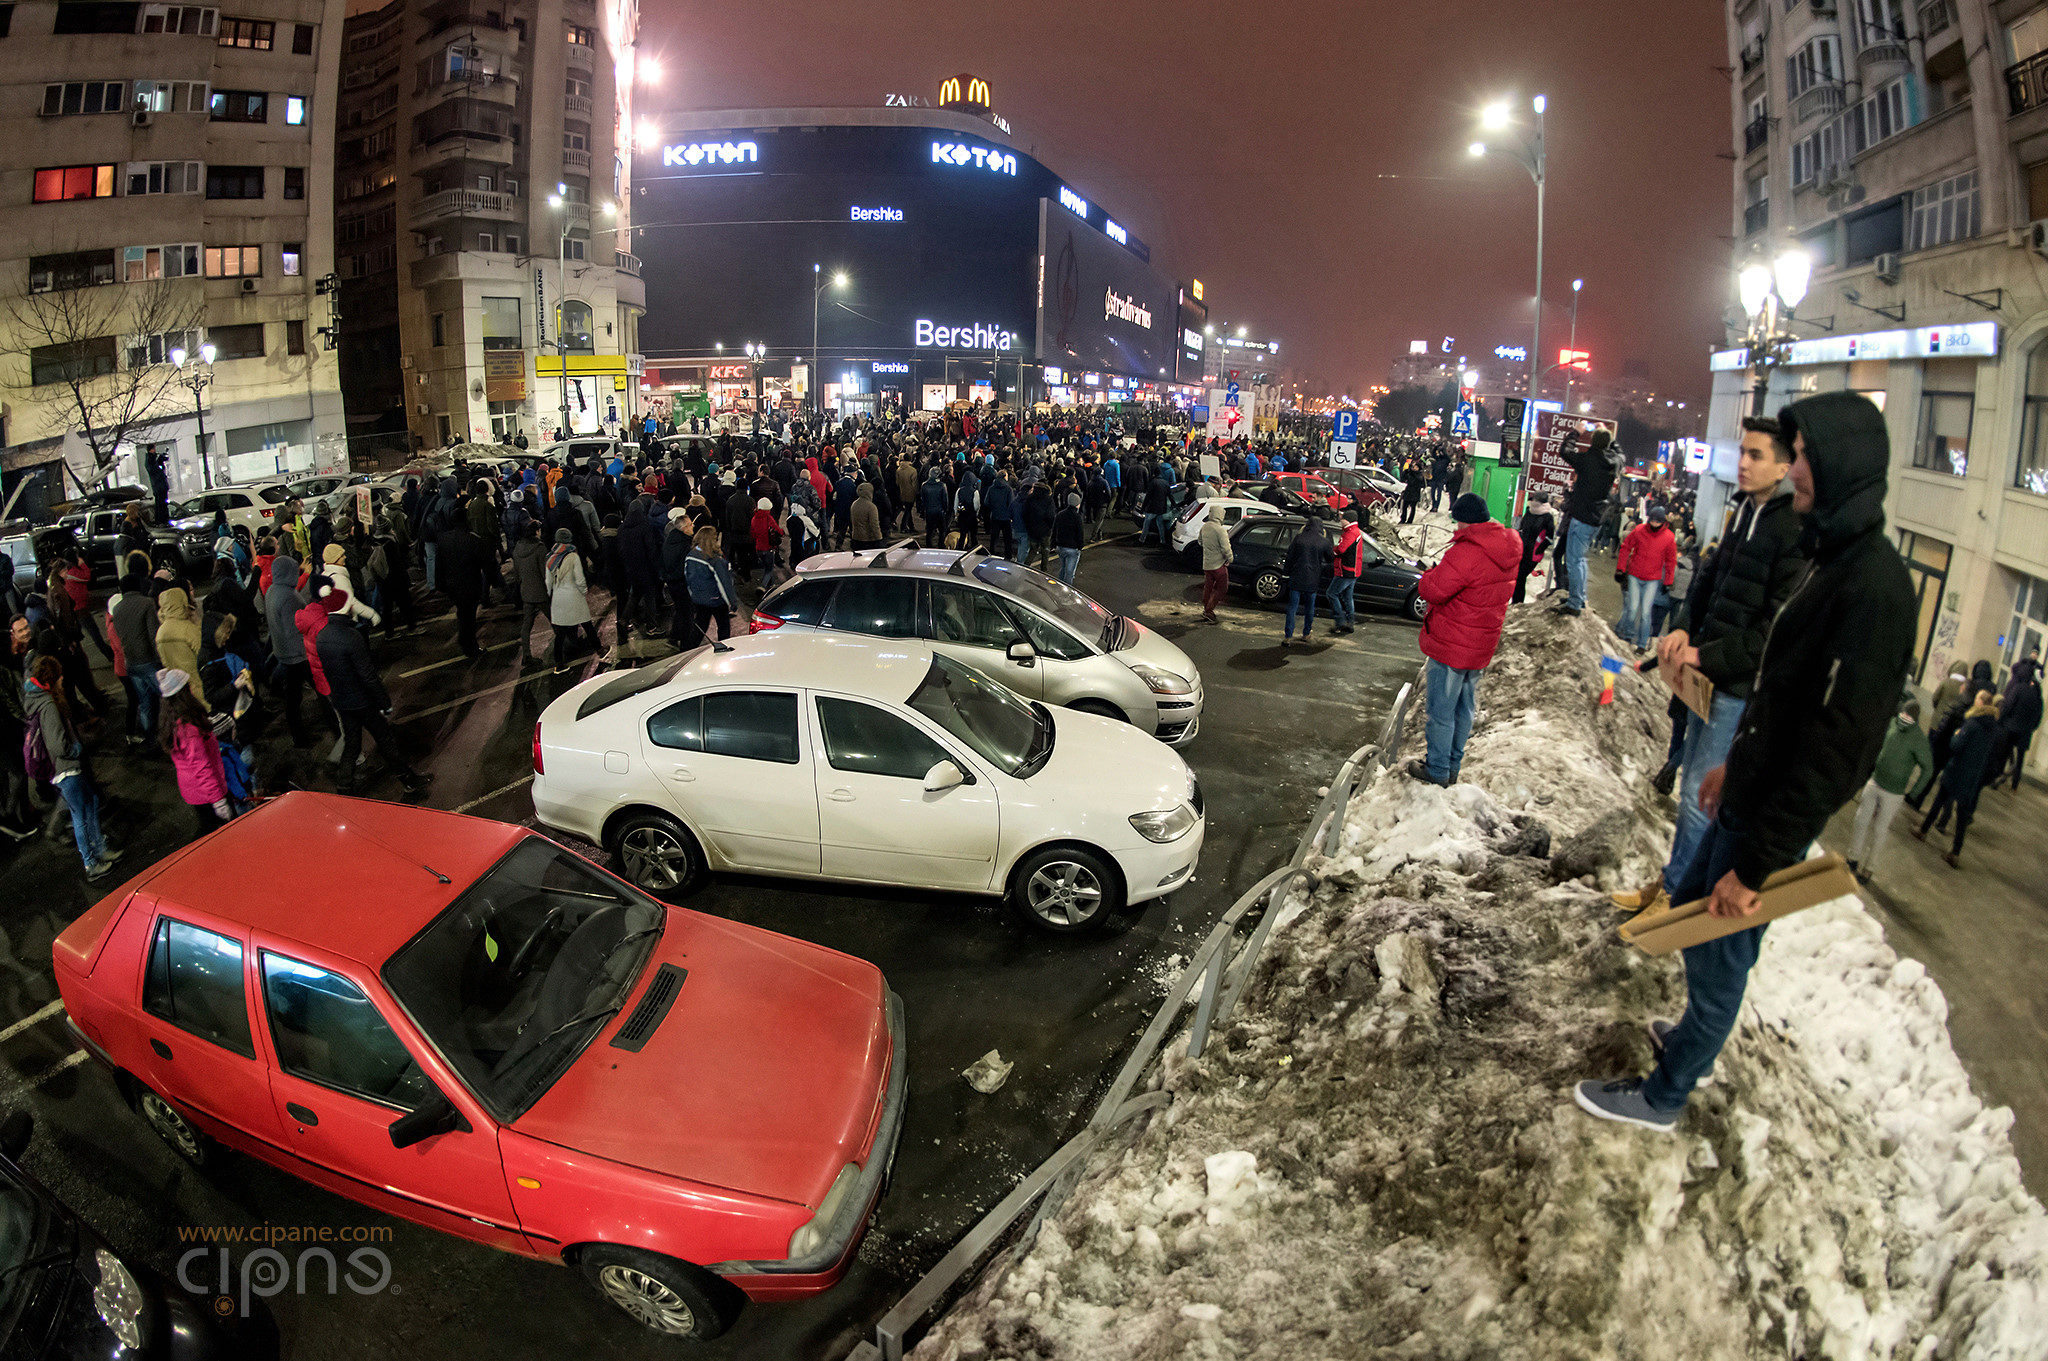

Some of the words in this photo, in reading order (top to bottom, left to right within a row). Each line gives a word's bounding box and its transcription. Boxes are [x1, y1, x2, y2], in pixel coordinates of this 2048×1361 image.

[885, 93, 931, 107] ZARA
[993, 112, 1011, 136] ZARA
[664, 141, 758, 166] KOTON
[931, 142, 1017, 176] KOTON
[850, 205, 904, 222] Bershka
[915, 318, 1011, 350] Bershka
[1945, 333, 1971, 347] BRD
[710, 366, 745, 378] KFC
[872, 362, 909, 373] Bershka
